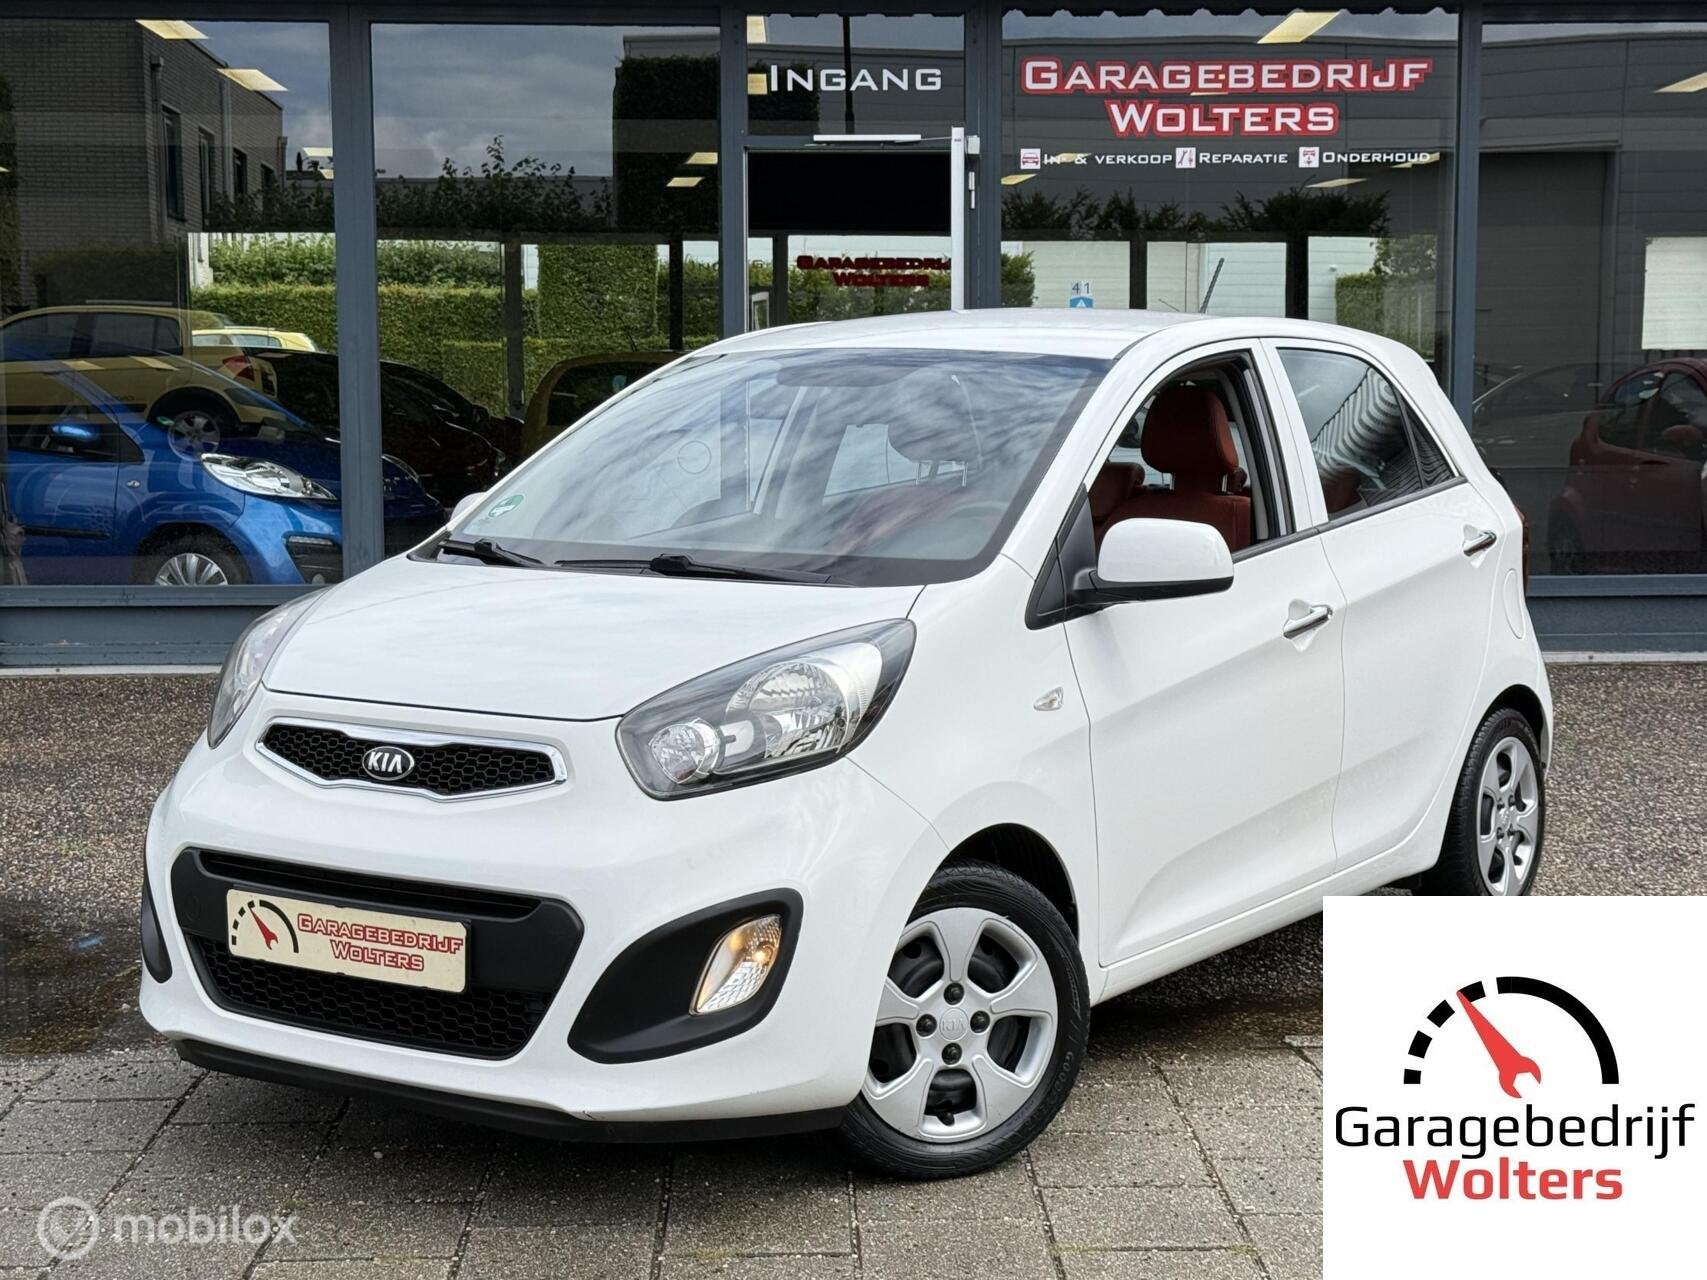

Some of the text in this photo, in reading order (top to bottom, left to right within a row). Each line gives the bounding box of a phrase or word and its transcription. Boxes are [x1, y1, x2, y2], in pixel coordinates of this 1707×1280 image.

[768, 64, 943, 92] INGANG
[1021, 57, 1433, 95] GARAGEBEDRIJF
[1105, 100, 1339, 137] WOLTERS
[1074, 153, 1088, 165] &
[1094, 154, 1173, 165] VERKOOP
[1199, 152, 1289, 164] REPARATIE
[1322, 151, 1431, 164] ONDERHOUD
[1071, 282, 1090, 295] 41
[367, 751, 402, 773] KIA
[298, 913, 463, 954] GARAGEBEDRIJF
[330, 939, 424, 971] WOLTERS
